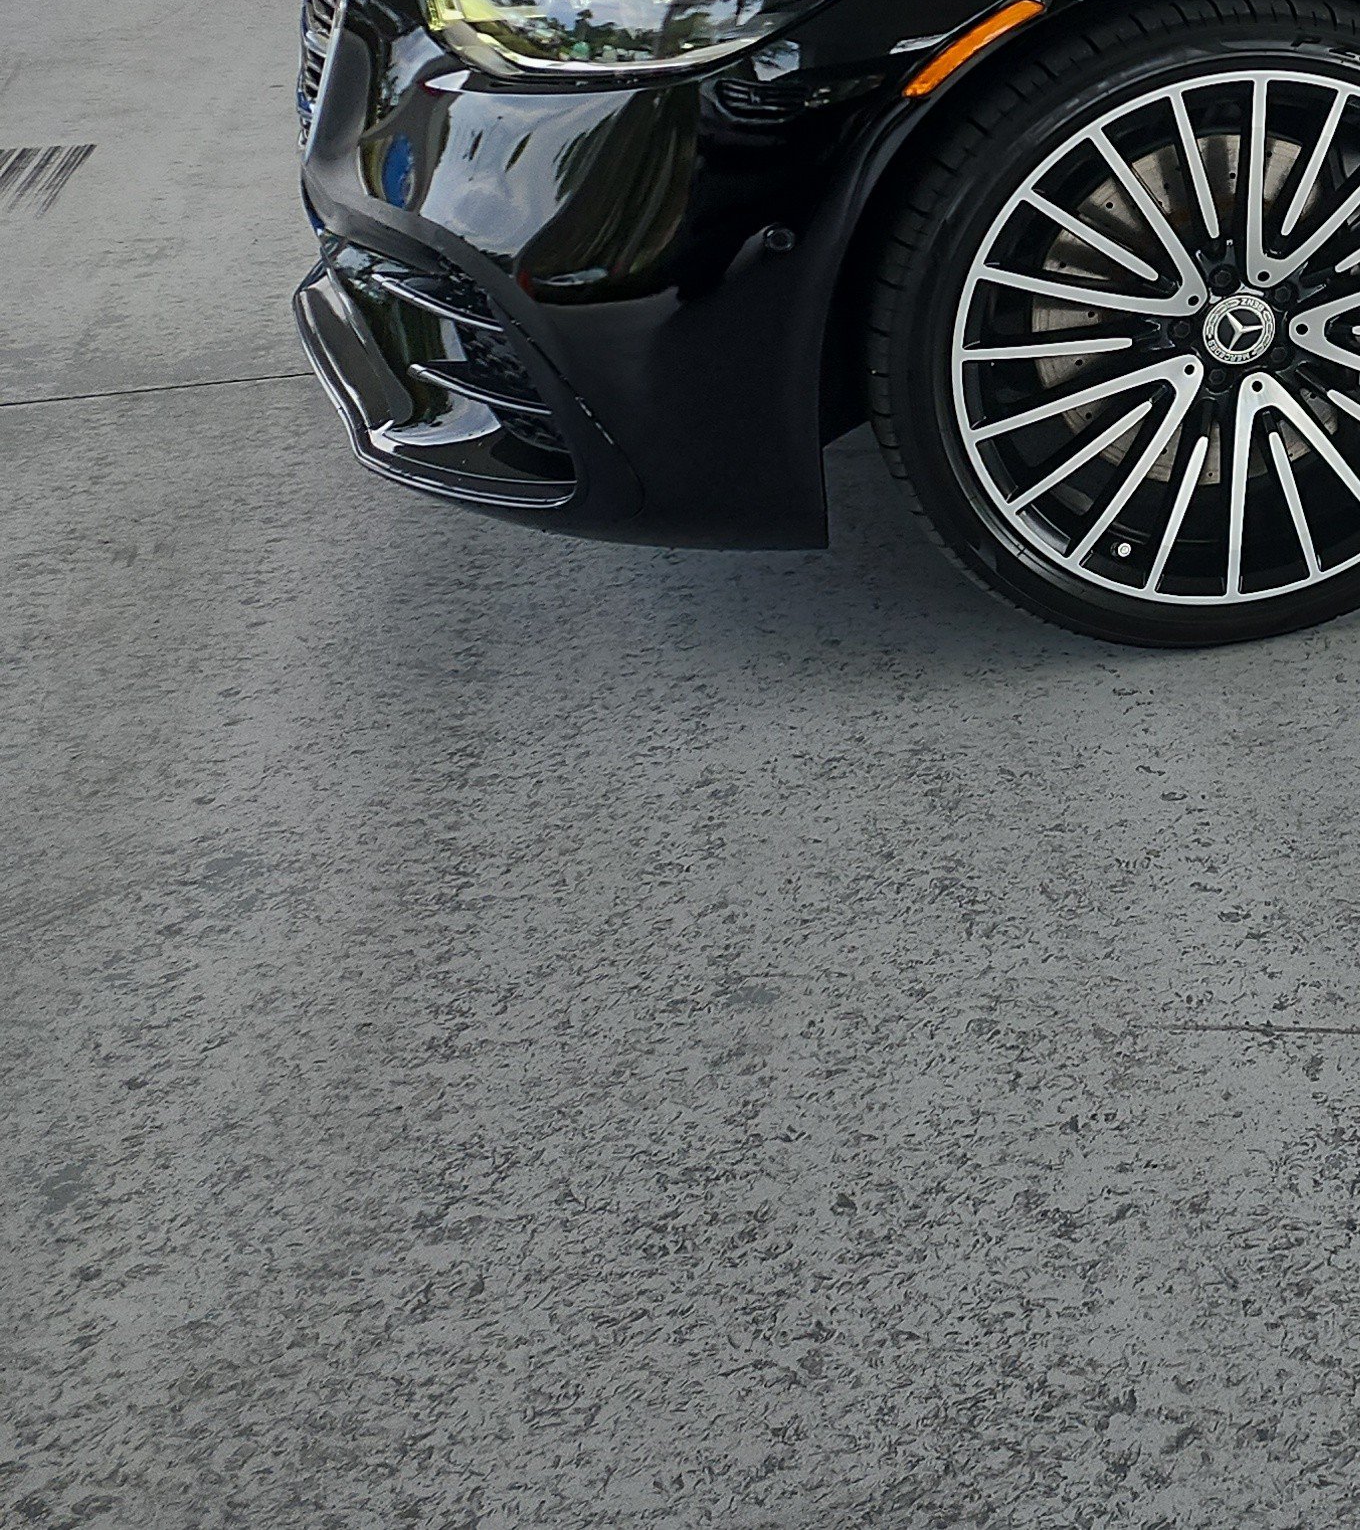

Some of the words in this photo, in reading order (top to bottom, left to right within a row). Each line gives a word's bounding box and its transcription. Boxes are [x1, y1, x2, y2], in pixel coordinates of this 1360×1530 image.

[1290, 34, 1322, 47] P
[1240, 298, 1265, 312] BENZ
[1207, 339, 1251, 362] MERCEDES
